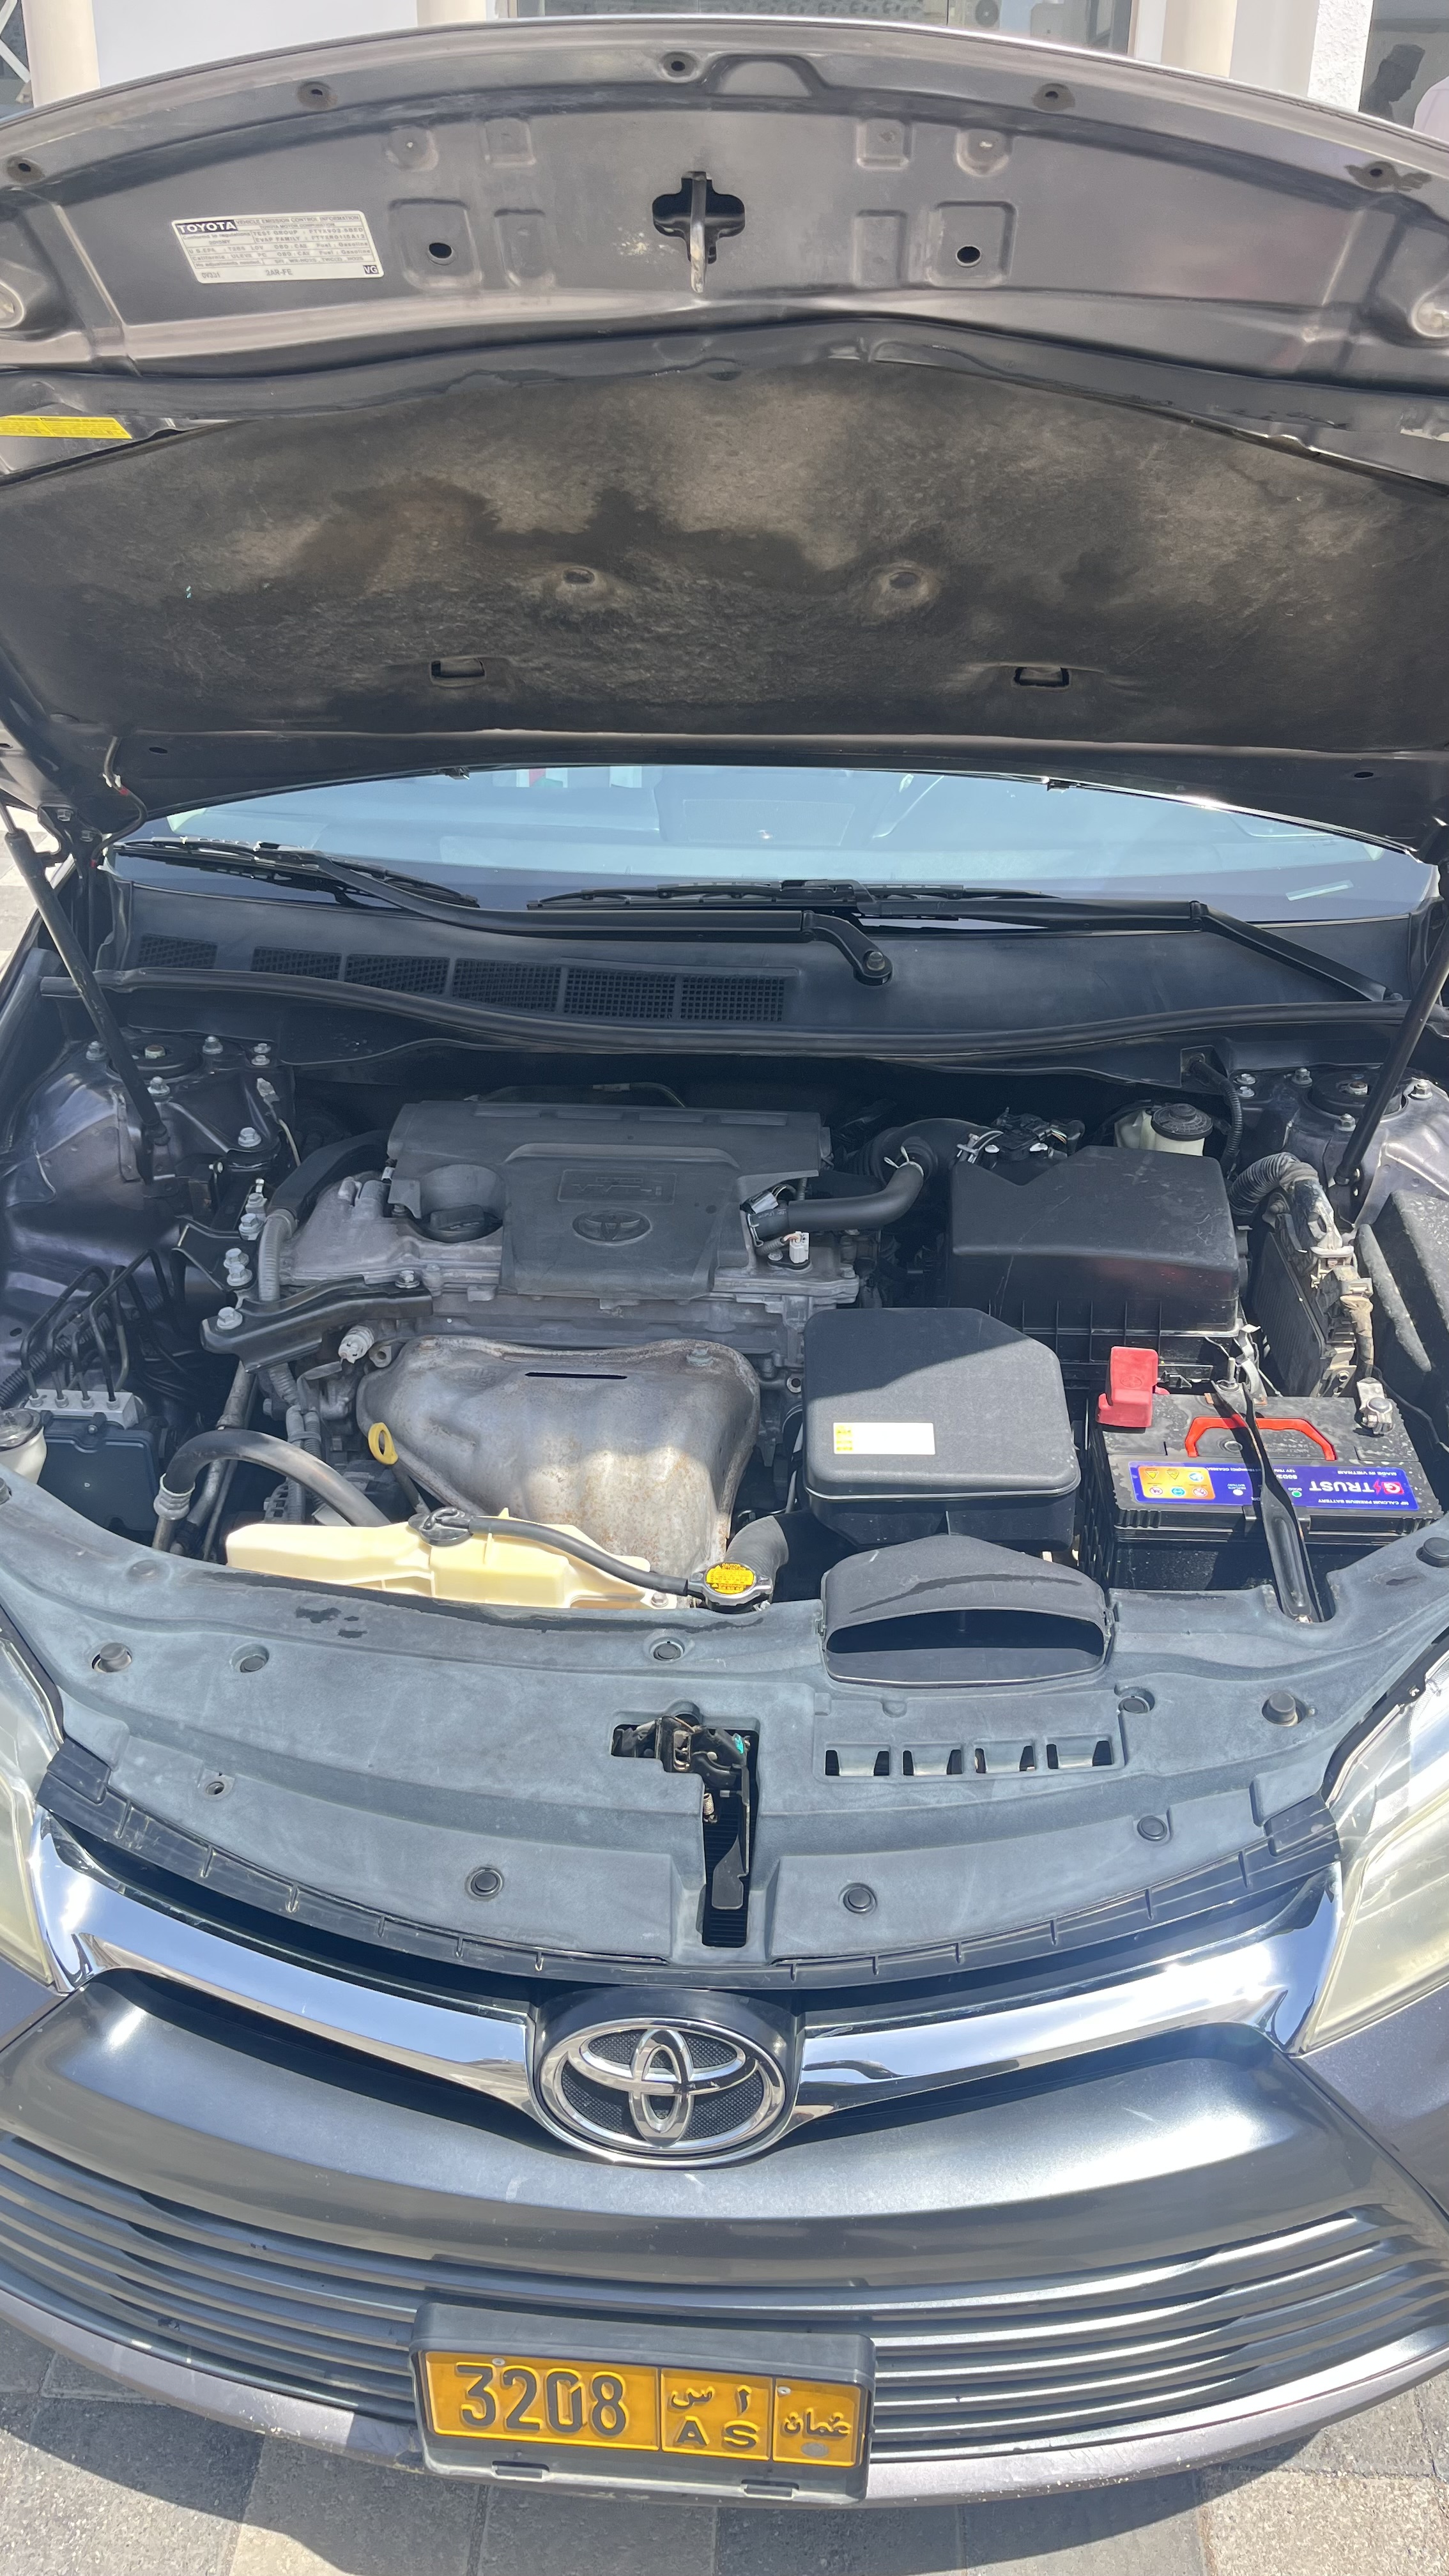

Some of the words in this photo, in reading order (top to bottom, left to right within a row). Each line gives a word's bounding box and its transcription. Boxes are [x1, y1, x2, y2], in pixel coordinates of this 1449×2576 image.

[177, 221, 237, 234] TOYOTA
[364, 265, 378, 273] VG
[1309, 1480, 1375, 1492] TRUST
[455, 2362, 629, 2437] 3208
[675, 2415, 710, 2446] A
[723, 2419, 761, 2450] S
